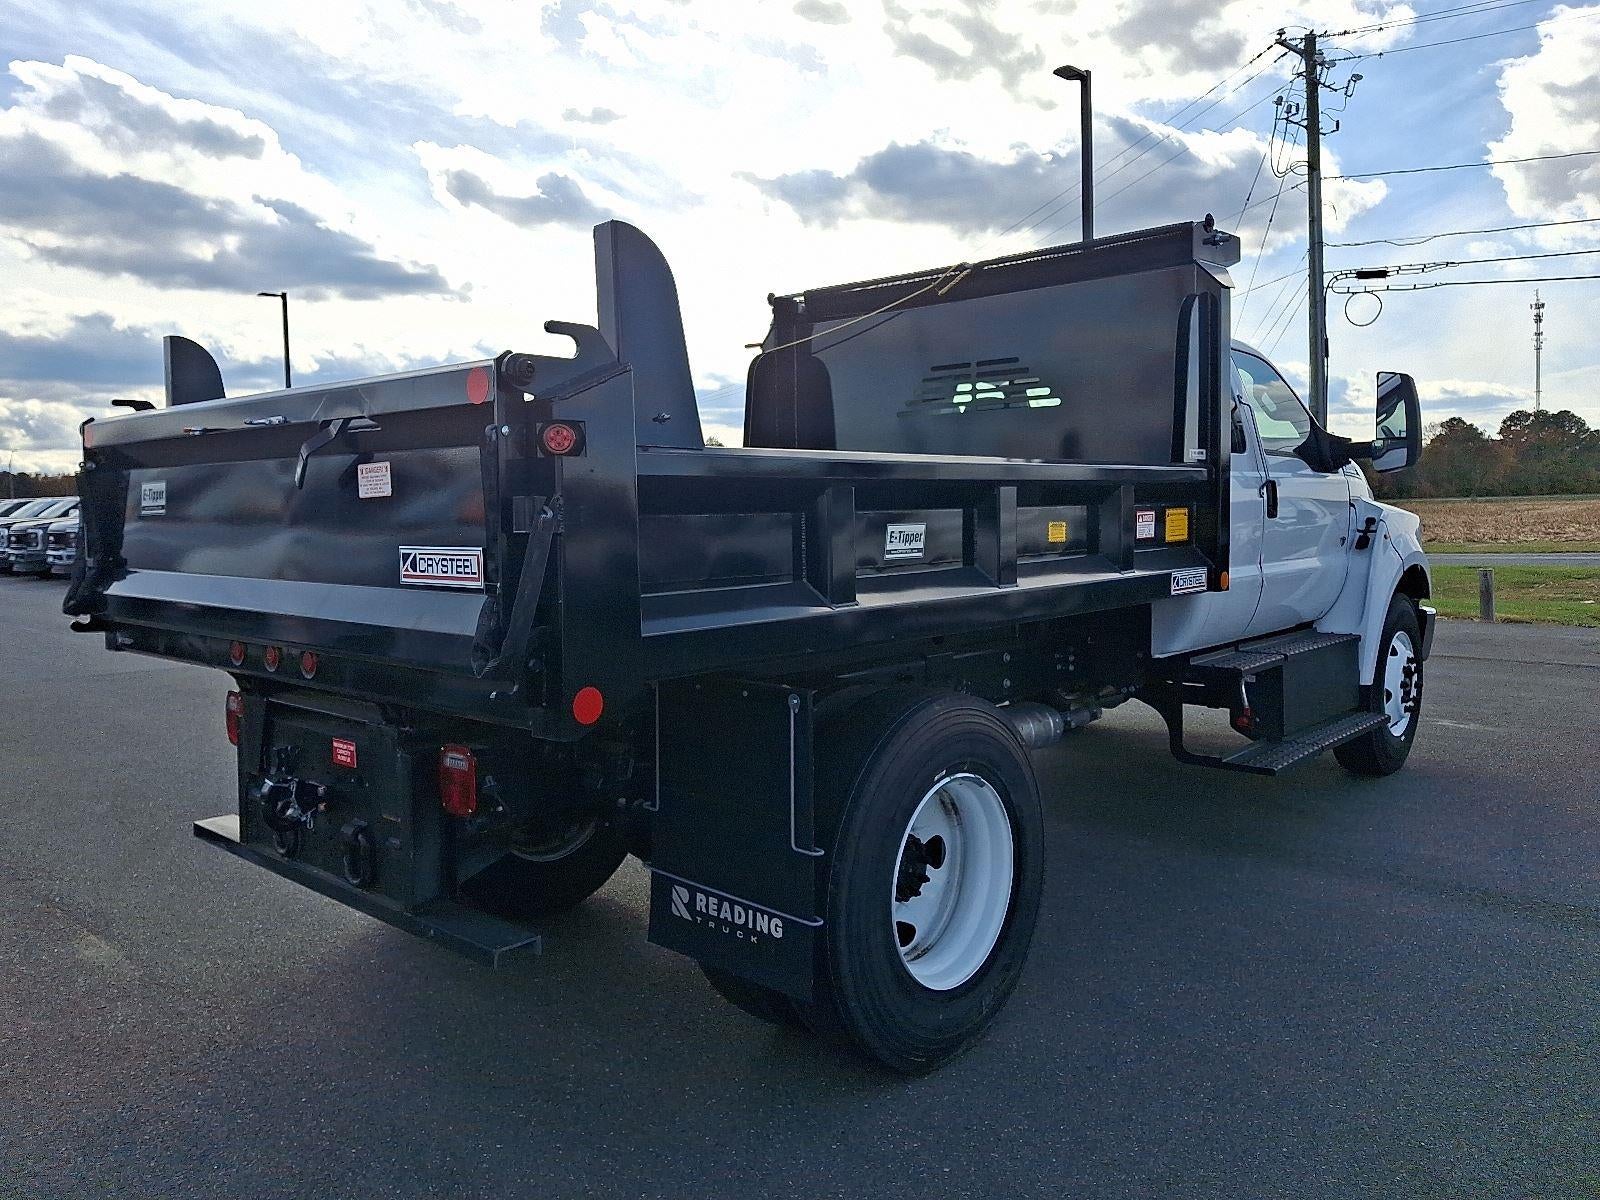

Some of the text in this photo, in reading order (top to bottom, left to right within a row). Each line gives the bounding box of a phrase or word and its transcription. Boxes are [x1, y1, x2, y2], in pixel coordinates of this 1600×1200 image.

[889, 530, 922, 546] E-Tipper
[418, 558, 477, 575] CRYSTEEL
[696, 892, 783, 938] READING
[696, 916, 758, 944] TRUCK
